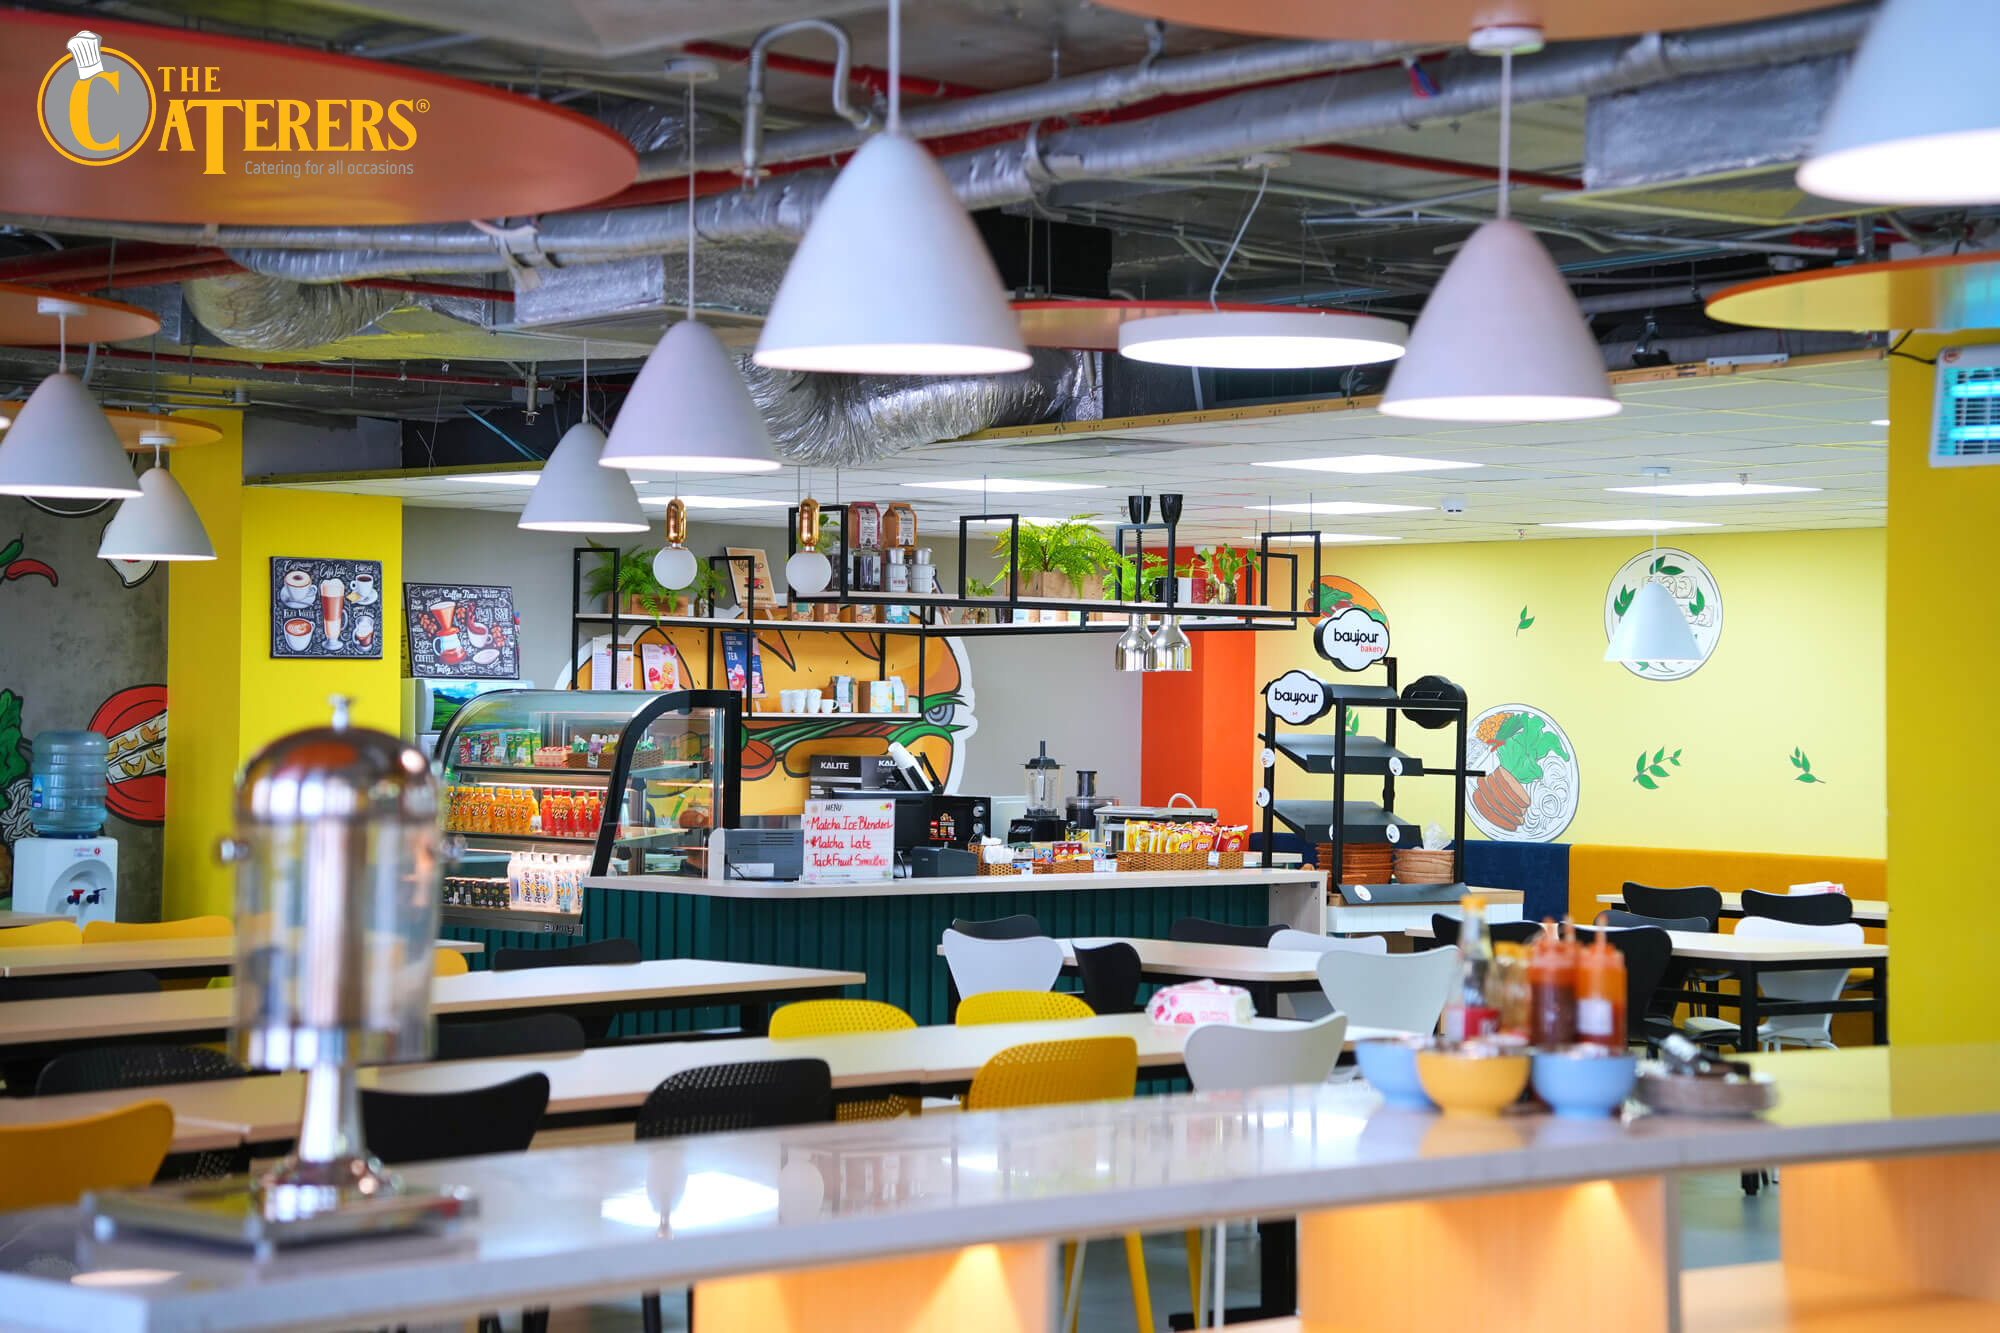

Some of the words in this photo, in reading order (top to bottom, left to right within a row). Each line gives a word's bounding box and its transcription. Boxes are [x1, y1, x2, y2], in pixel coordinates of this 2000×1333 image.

[1334, 628, 1379, 646] baujour
[1360, 645, 1383, 654] bakery
[1275, 688, 1318, 705] baujour
[820, 761, 849, 770] KALITE
[825, 802, 842, 812] MENU
[811, 816, 840, 830] Matcha
[811, 834, 844, 849] Matcha
